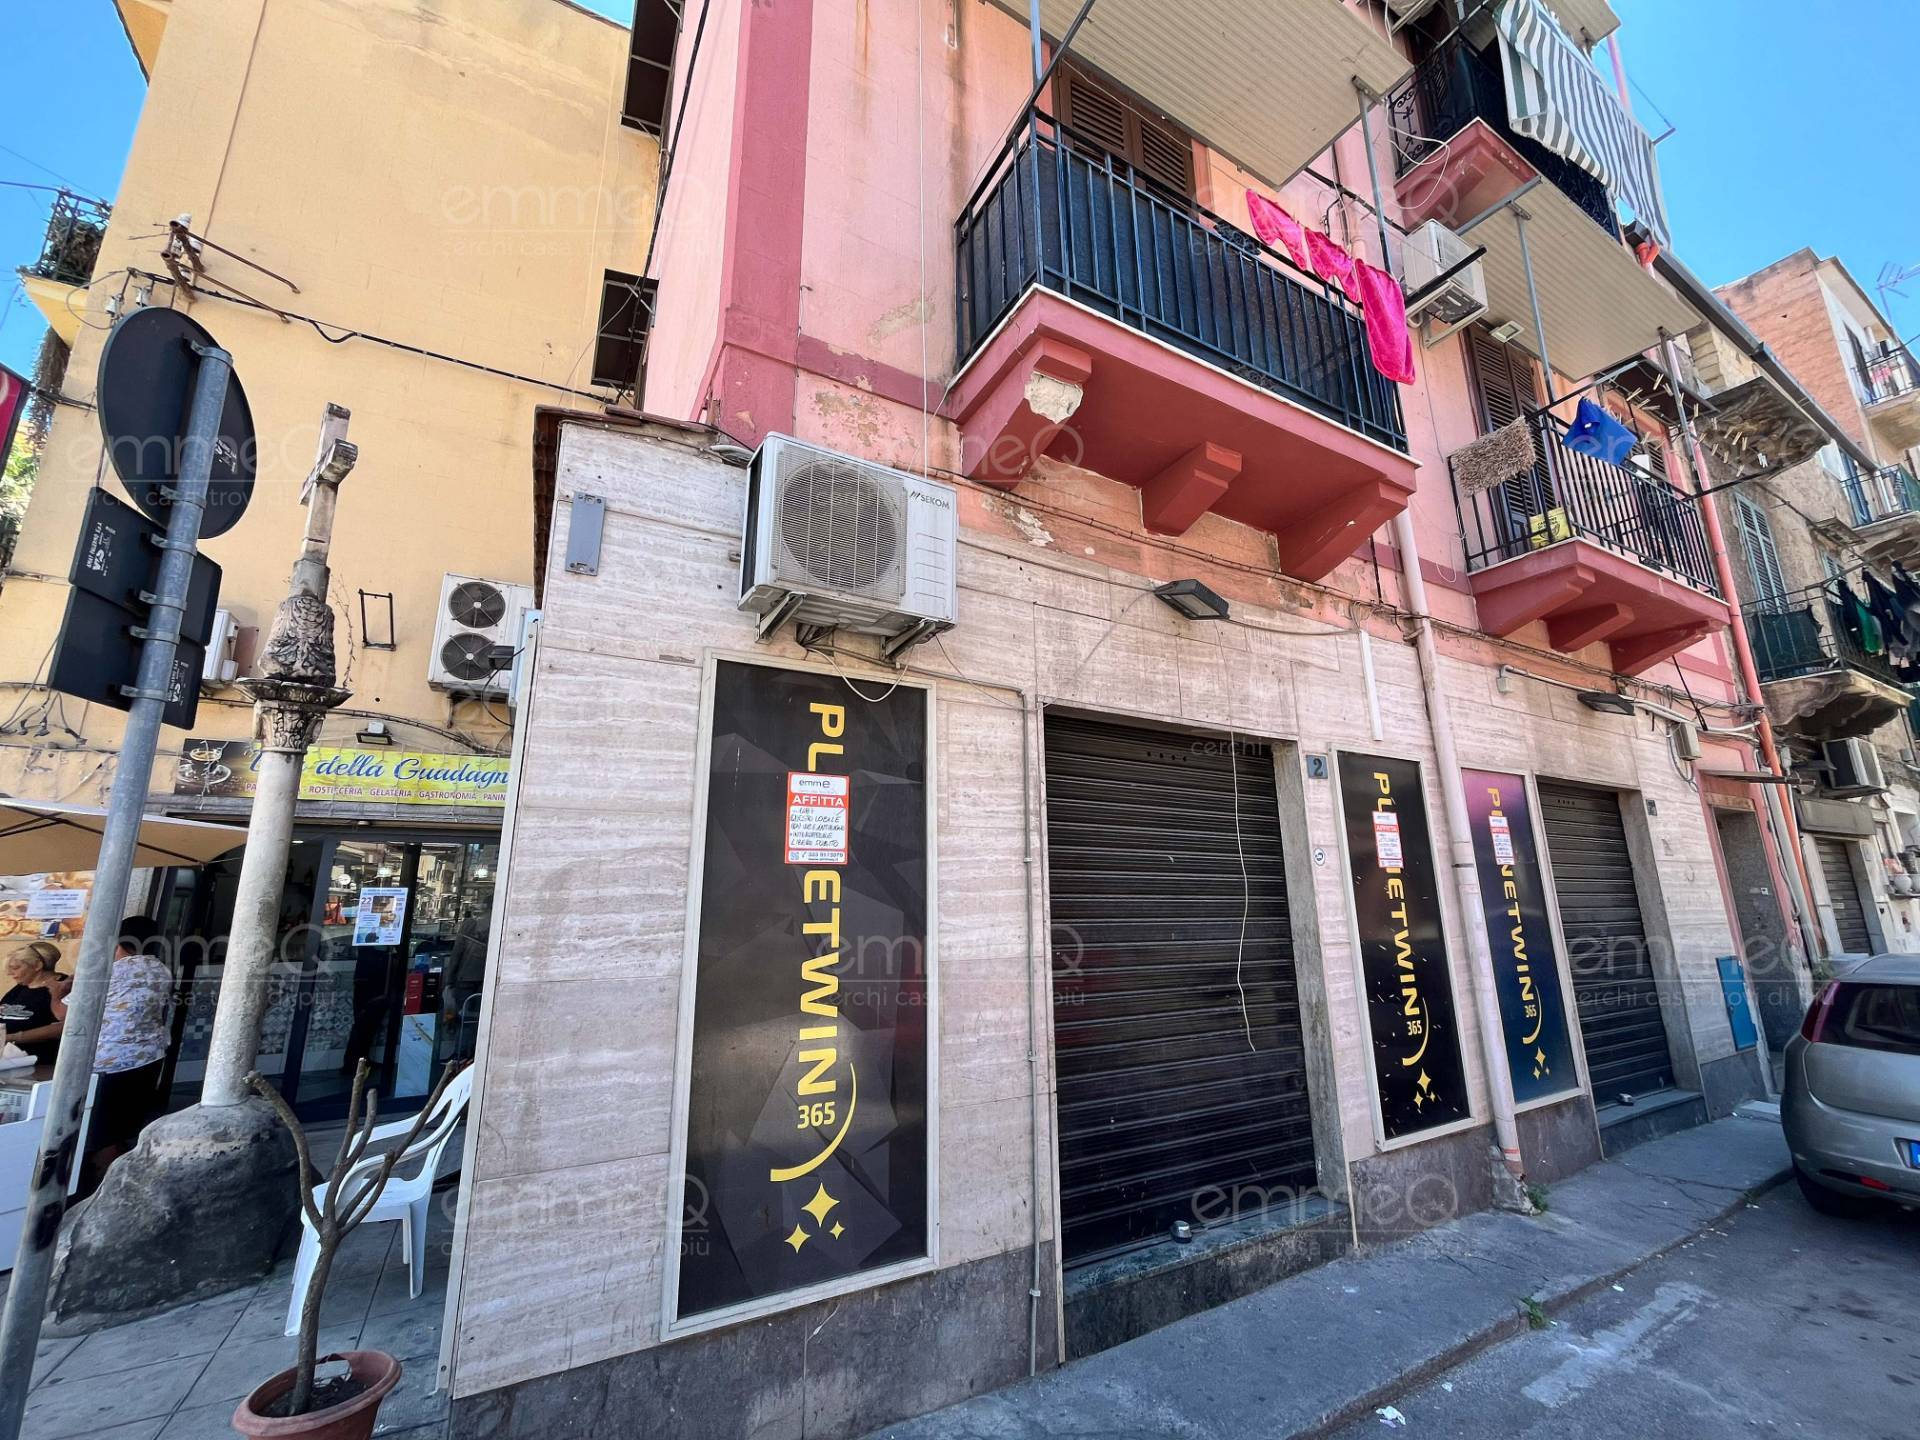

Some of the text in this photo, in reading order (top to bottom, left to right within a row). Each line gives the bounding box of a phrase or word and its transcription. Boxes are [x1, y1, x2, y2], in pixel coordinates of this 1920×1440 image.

[920, 494, 950, 510] SEKOM
[316, 754, 384, 777] della
[393, 758, 509, 789] Guadagn
[1313, 758, 1324, 777] 2
[370, 788, 412, 797] GELATERIA
[419, 790, 477, 801] GASTRONOMIA
[483, 792, 507, 802] PANIN
[792, 795, 845, 807] AFFITTA
[798, 703, 845, 1097] PLETWIN
[1373, 772, 1420, 1016] PLETWIN
[1524, 1004, 1537, 1018] 365
[1406, 1020, 1423, 1036] 365
[797, 1101, 836, 1129] 365
